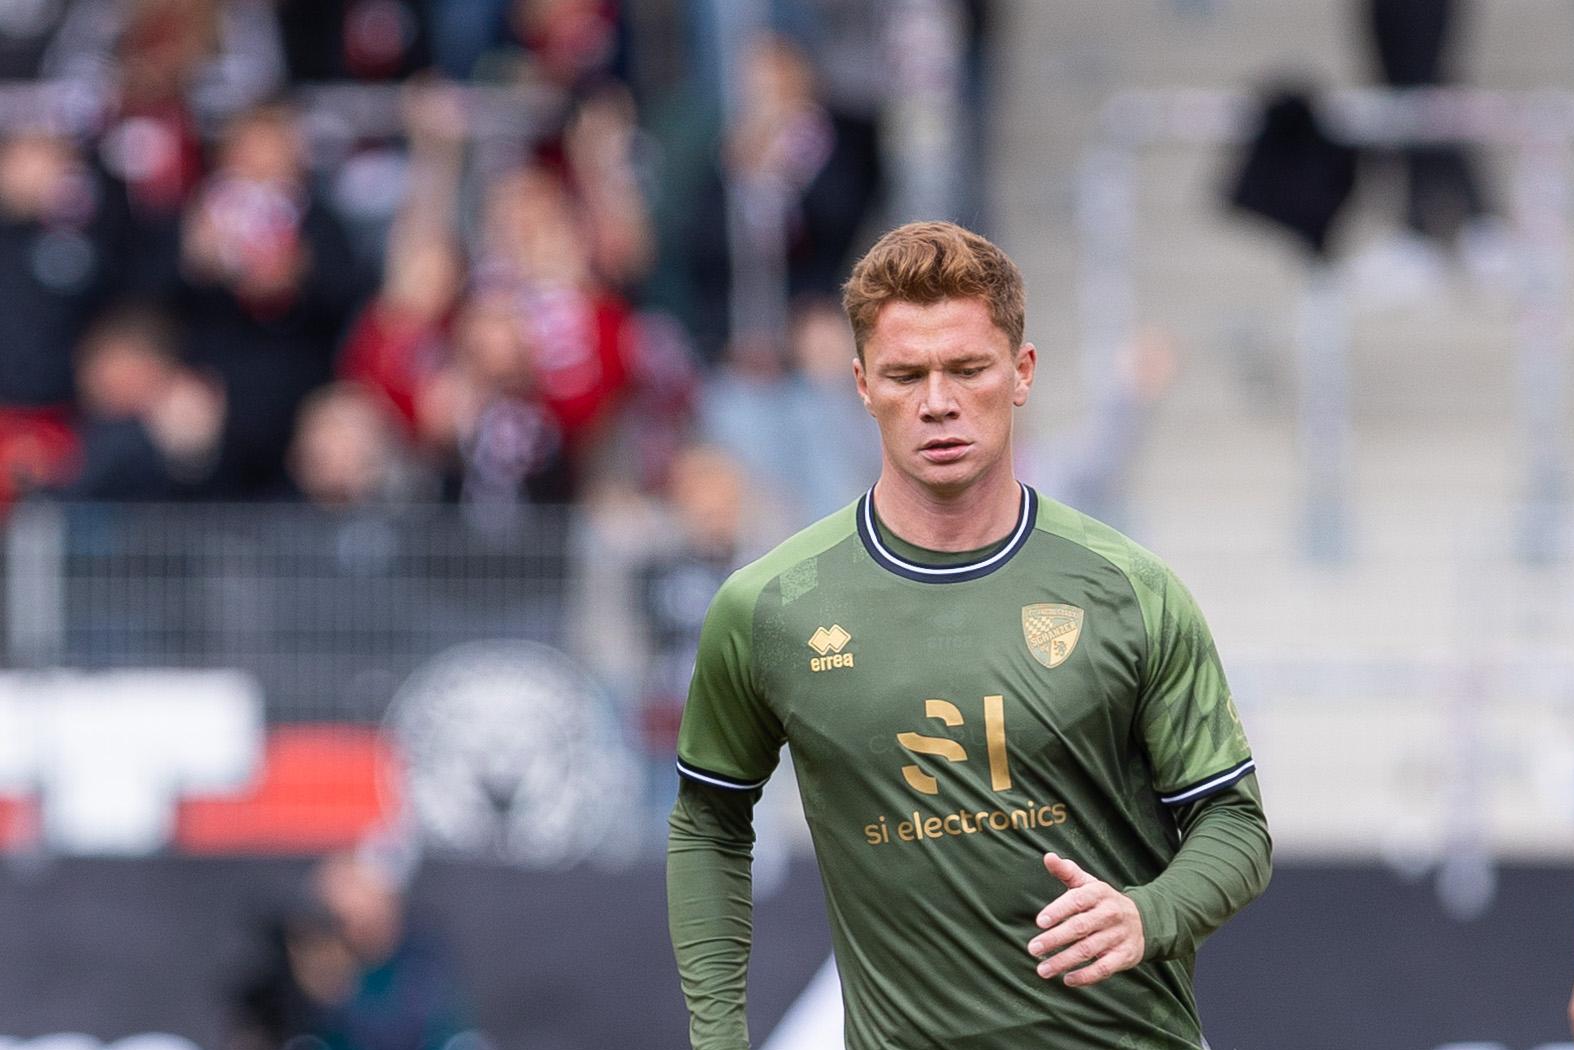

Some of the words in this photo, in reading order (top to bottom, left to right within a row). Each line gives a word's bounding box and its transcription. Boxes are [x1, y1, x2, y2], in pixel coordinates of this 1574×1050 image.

[810, 653, 854, 672] errea
[864, 816, 890, 845] si
[897, 800, 1068, 842] electronics
